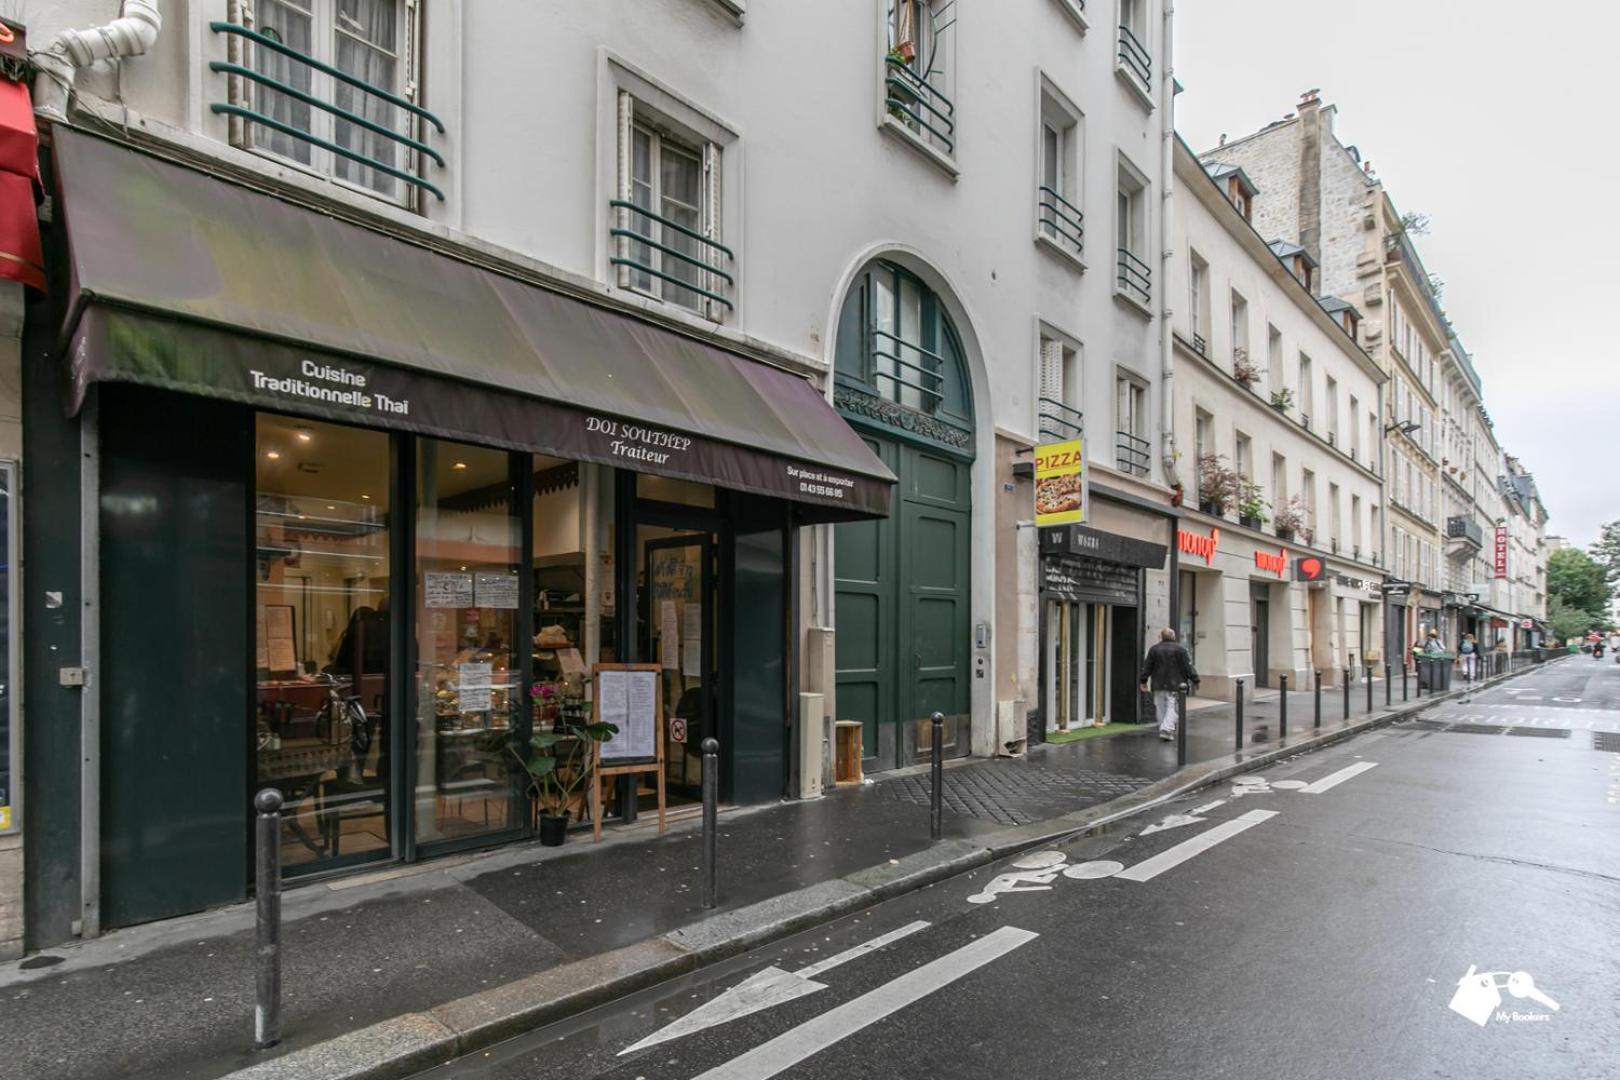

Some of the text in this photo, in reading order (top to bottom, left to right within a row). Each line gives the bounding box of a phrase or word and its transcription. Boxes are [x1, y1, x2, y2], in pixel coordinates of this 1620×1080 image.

[301, 359, 366, 387] Cuisine
[249, 369, 409, 415] Traditionnelle Thaï
[586, 416, 692, 451] DOI SOUTHEP
[610, 440, 670, 465] Traiteur
[1035, 450, 1082, 469] PIZZA
[1051, 532, 1063, 544] W
